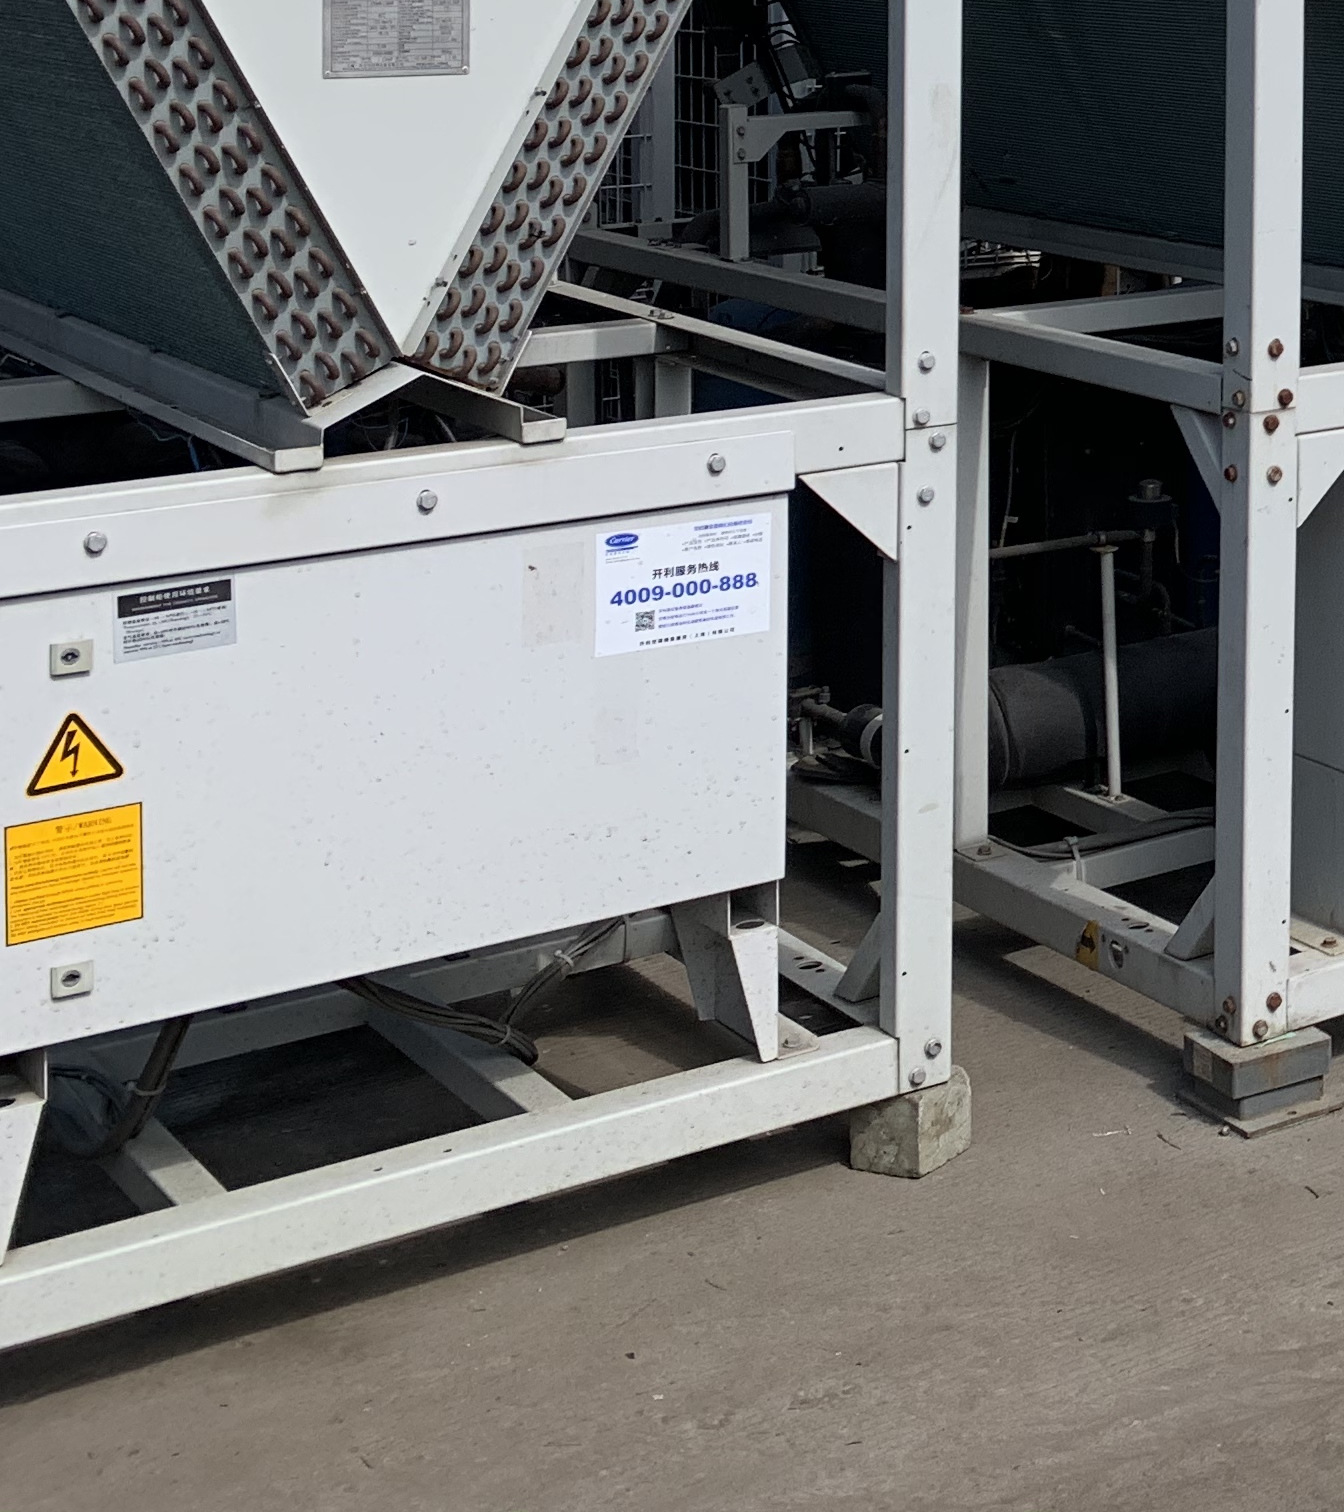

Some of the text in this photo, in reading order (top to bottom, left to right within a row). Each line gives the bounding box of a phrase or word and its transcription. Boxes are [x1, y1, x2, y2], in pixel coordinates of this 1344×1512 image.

[652, 560, 720, 581] 开利服务热线
[610, 572, 758, 607] 4009-000-888
